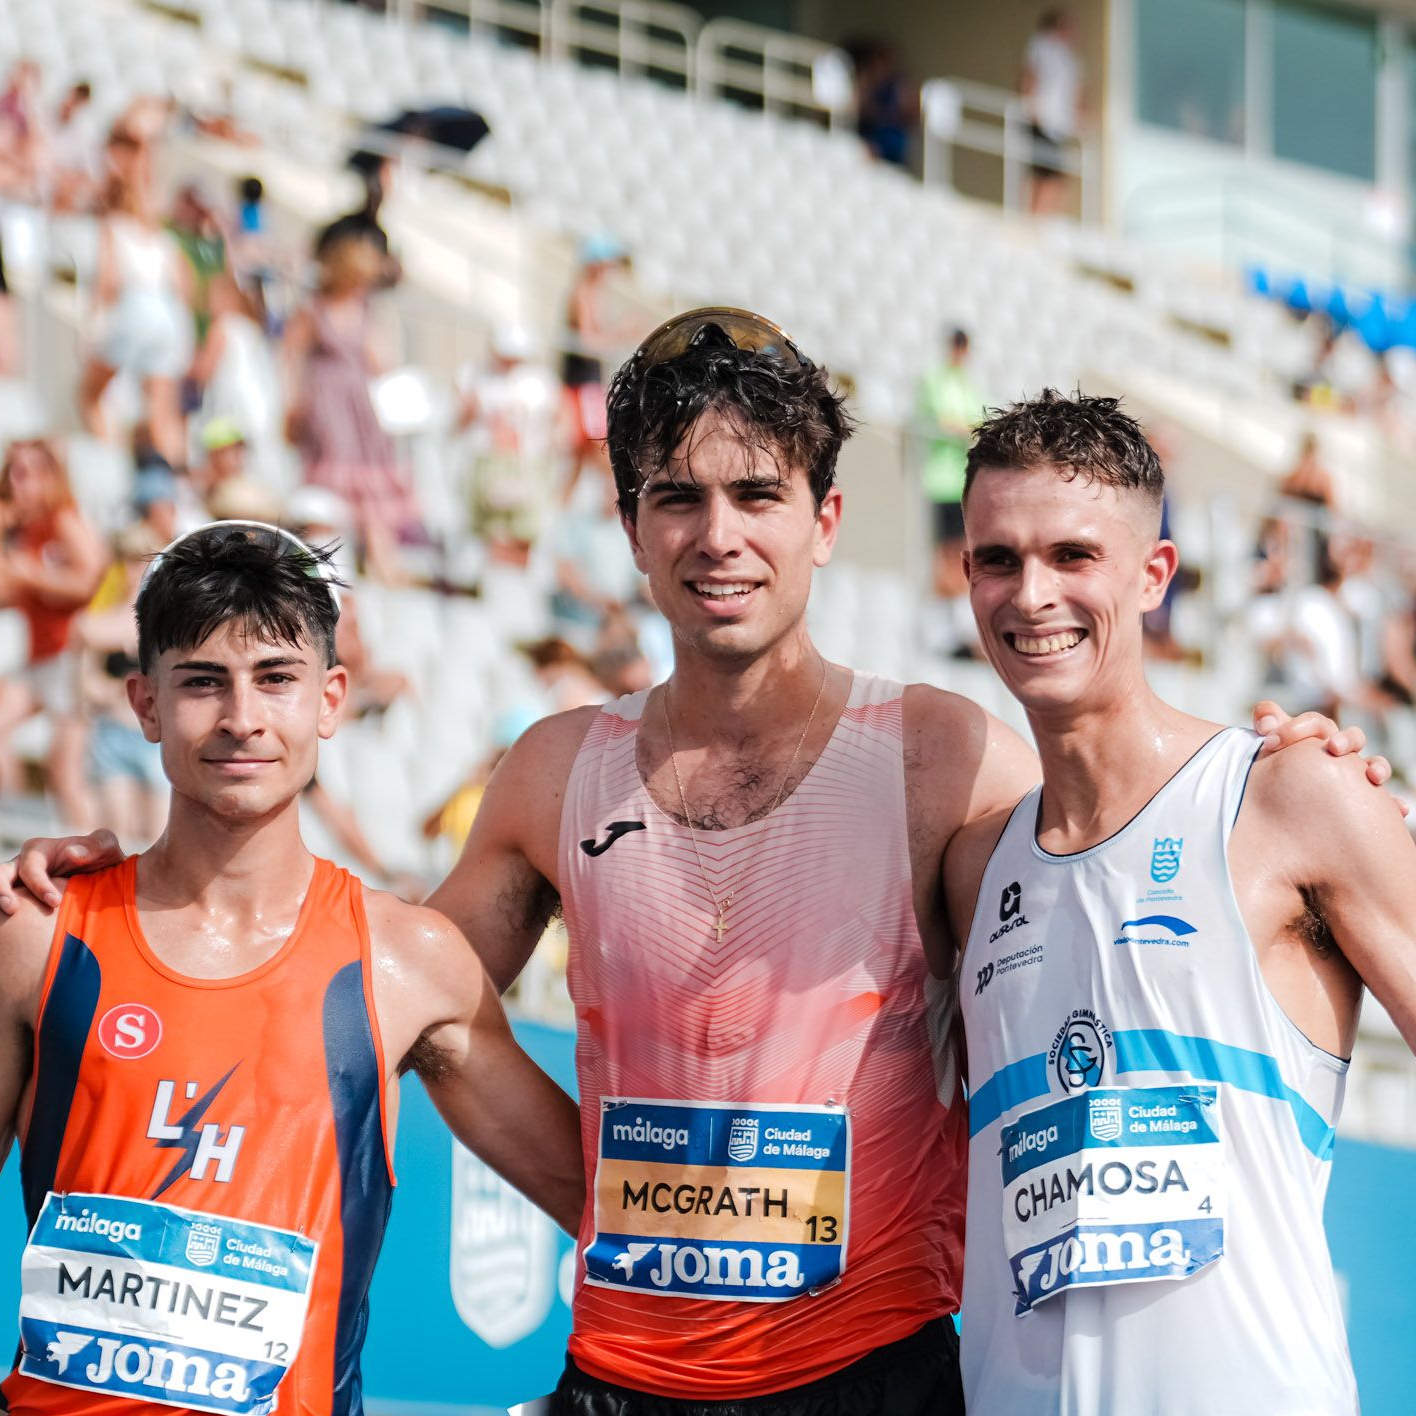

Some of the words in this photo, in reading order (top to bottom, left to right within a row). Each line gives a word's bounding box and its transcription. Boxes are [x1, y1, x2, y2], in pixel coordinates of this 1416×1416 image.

[996, 955, 1043, 977] Pontevedra
[997, 944, 1043, 967] Deputación
[114, 1013, 146, 1049] S
[1128, 1104, 1177, 1119] Ciudad
[613, 1116, 689, 1150] málaga
[764, 1127, 812, 1142] Ciudad
[1129, 1121, 1147, 1134] de
[1149, 1119, 1198, 1135] Málaga
[763, 1143, 780, 1156] de
[782, 1144, 831, 1159] Málaga
[622, 1179, 789, 1218] MCGRATH
[1014, 1160, 1190, 1223] CHAMOSA
[1197, 1195, 1213, 1214] 4
[55, 1208, 142, 1243] málaga
[805, 1215, 838, 1243] 13
[226, 1238, 272, 1258] Ciudad
[223, 1253, 239, 1267] de
[241, 1255, 289, 1277] Málaga
[58, 1261, 269, 1332] MARTINEZ
[264, 1340, 289, 1363] 12
